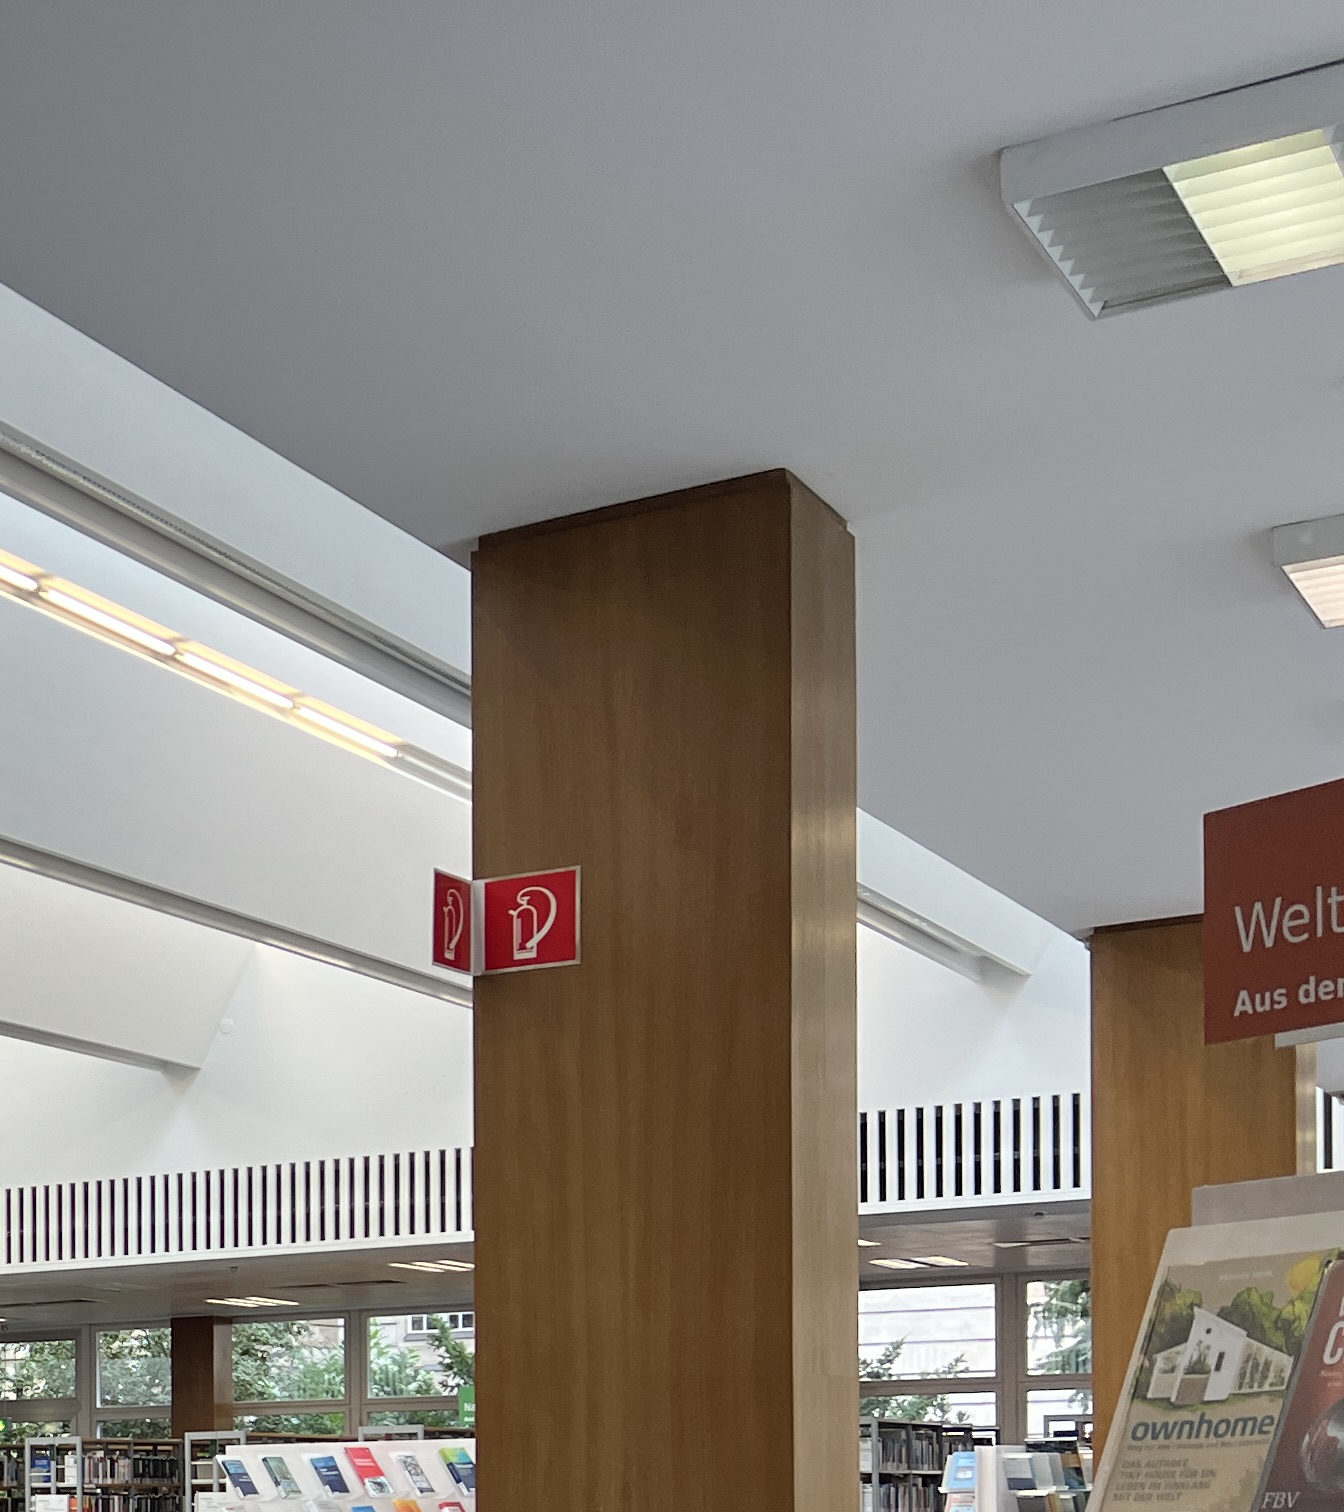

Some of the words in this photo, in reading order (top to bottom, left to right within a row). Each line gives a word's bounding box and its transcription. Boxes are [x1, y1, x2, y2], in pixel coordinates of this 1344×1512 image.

[1233, 988, 1288, 1017] Aus
[1130, 1412, 1275, 1441] ownhome
[1261, 1491, 1301, 1509] FBV
